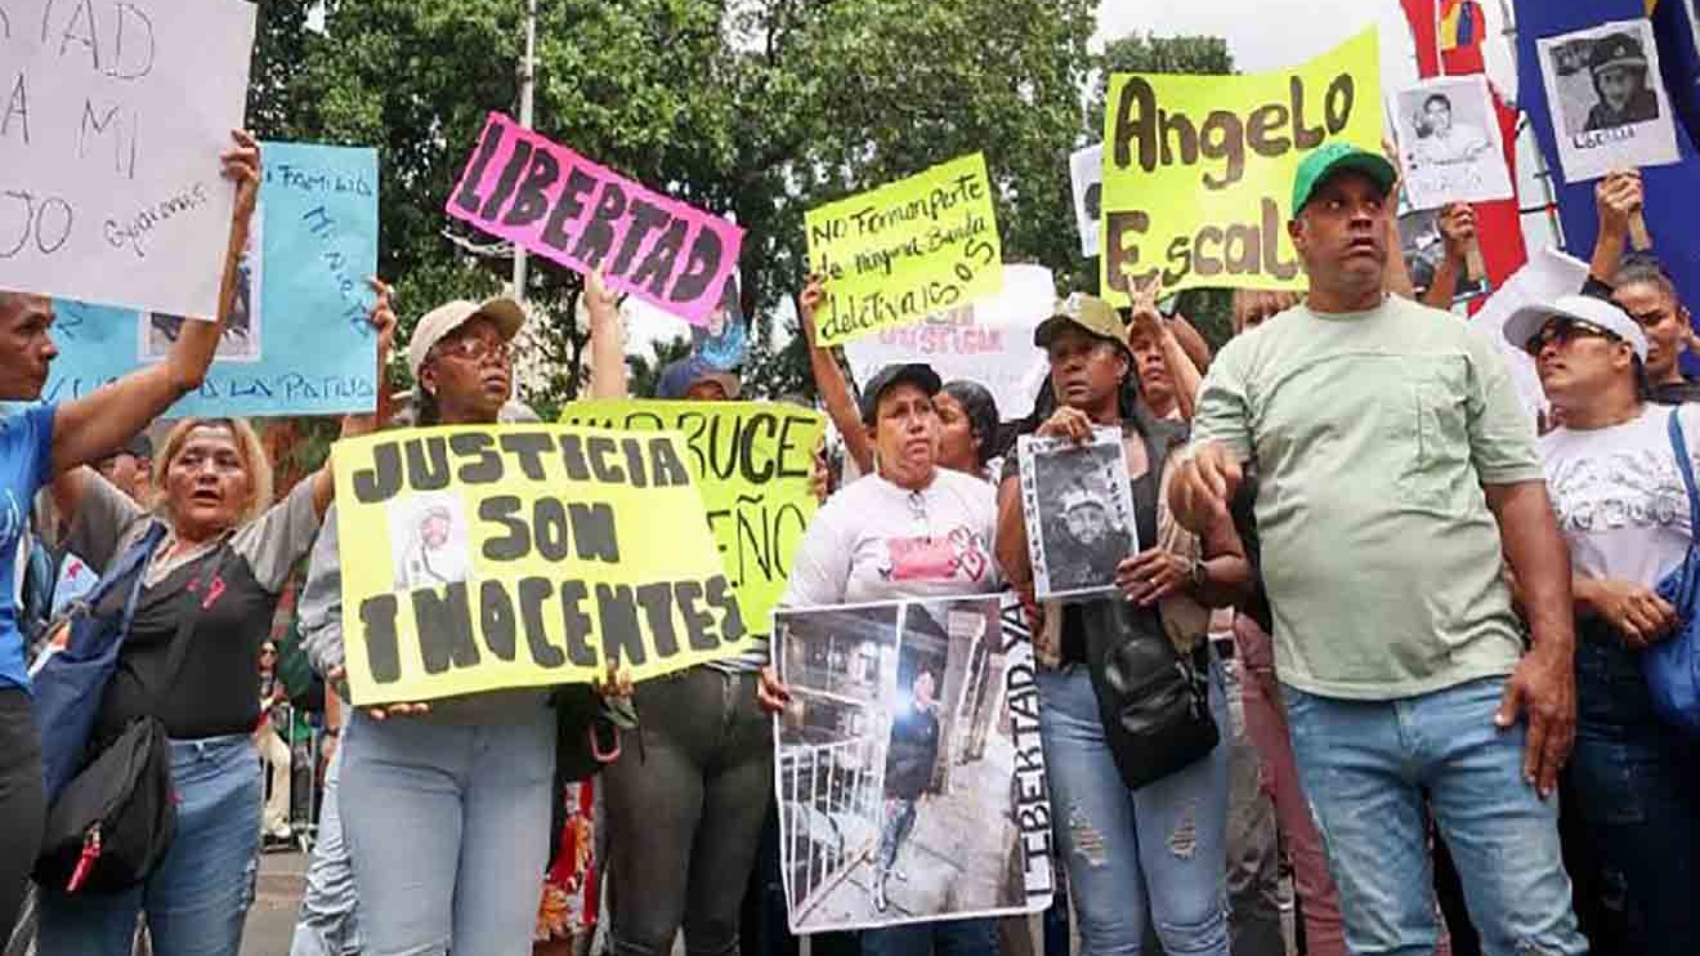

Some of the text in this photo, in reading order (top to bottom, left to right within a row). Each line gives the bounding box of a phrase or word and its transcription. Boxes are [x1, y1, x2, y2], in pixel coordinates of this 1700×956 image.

[79, 97, 137, 180] MI
[452, 121, 724, 303] LIBERTAD
[812, 217, 848, 248] NO
[1106, 196, 1300, 294] Escal
[352, 430, 690, 503] JUSTICIA
[478, 495, 621, 564] SON
[359, 574, 748, 684] INOCENTES
